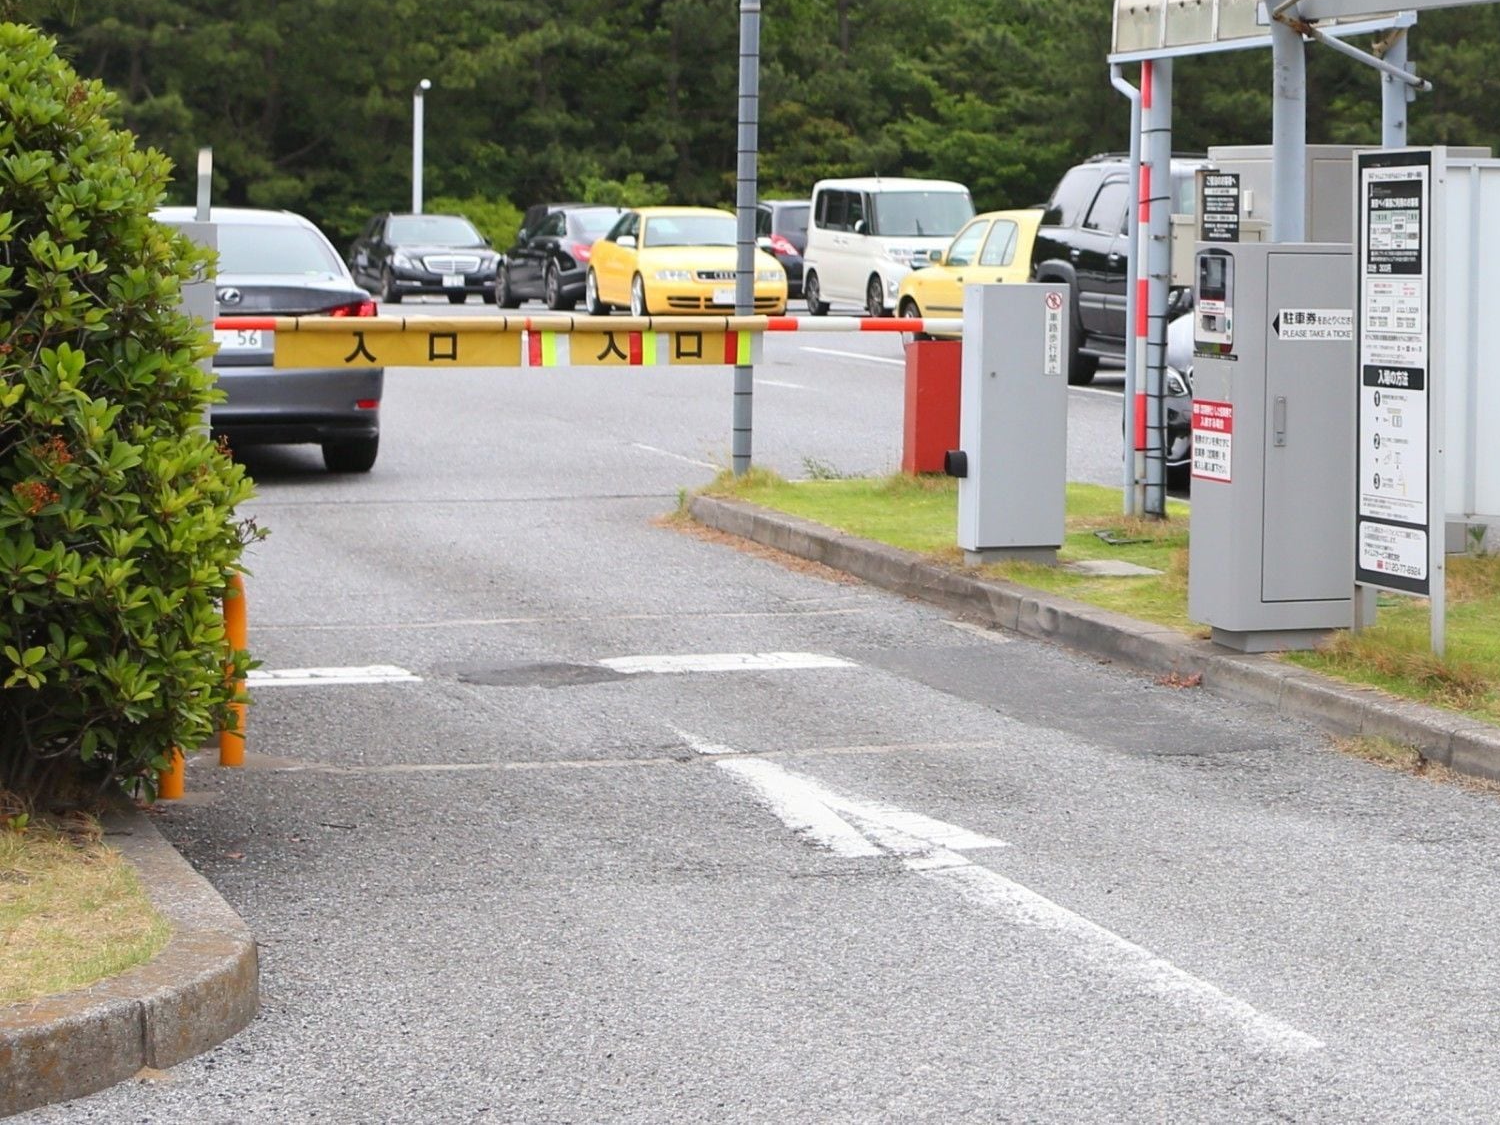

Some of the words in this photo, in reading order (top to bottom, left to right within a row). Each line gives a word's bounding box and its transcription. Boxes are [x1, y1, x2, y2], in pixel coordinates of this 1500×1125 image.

[345, 331, 457, 363] 入口
[597, 331, 702, 361] 入口
[1282, 330, 1307, 338] PLEASE
[1309, 330, 1325, 338] TAKE
[1326, 330, 1332, 338] A
